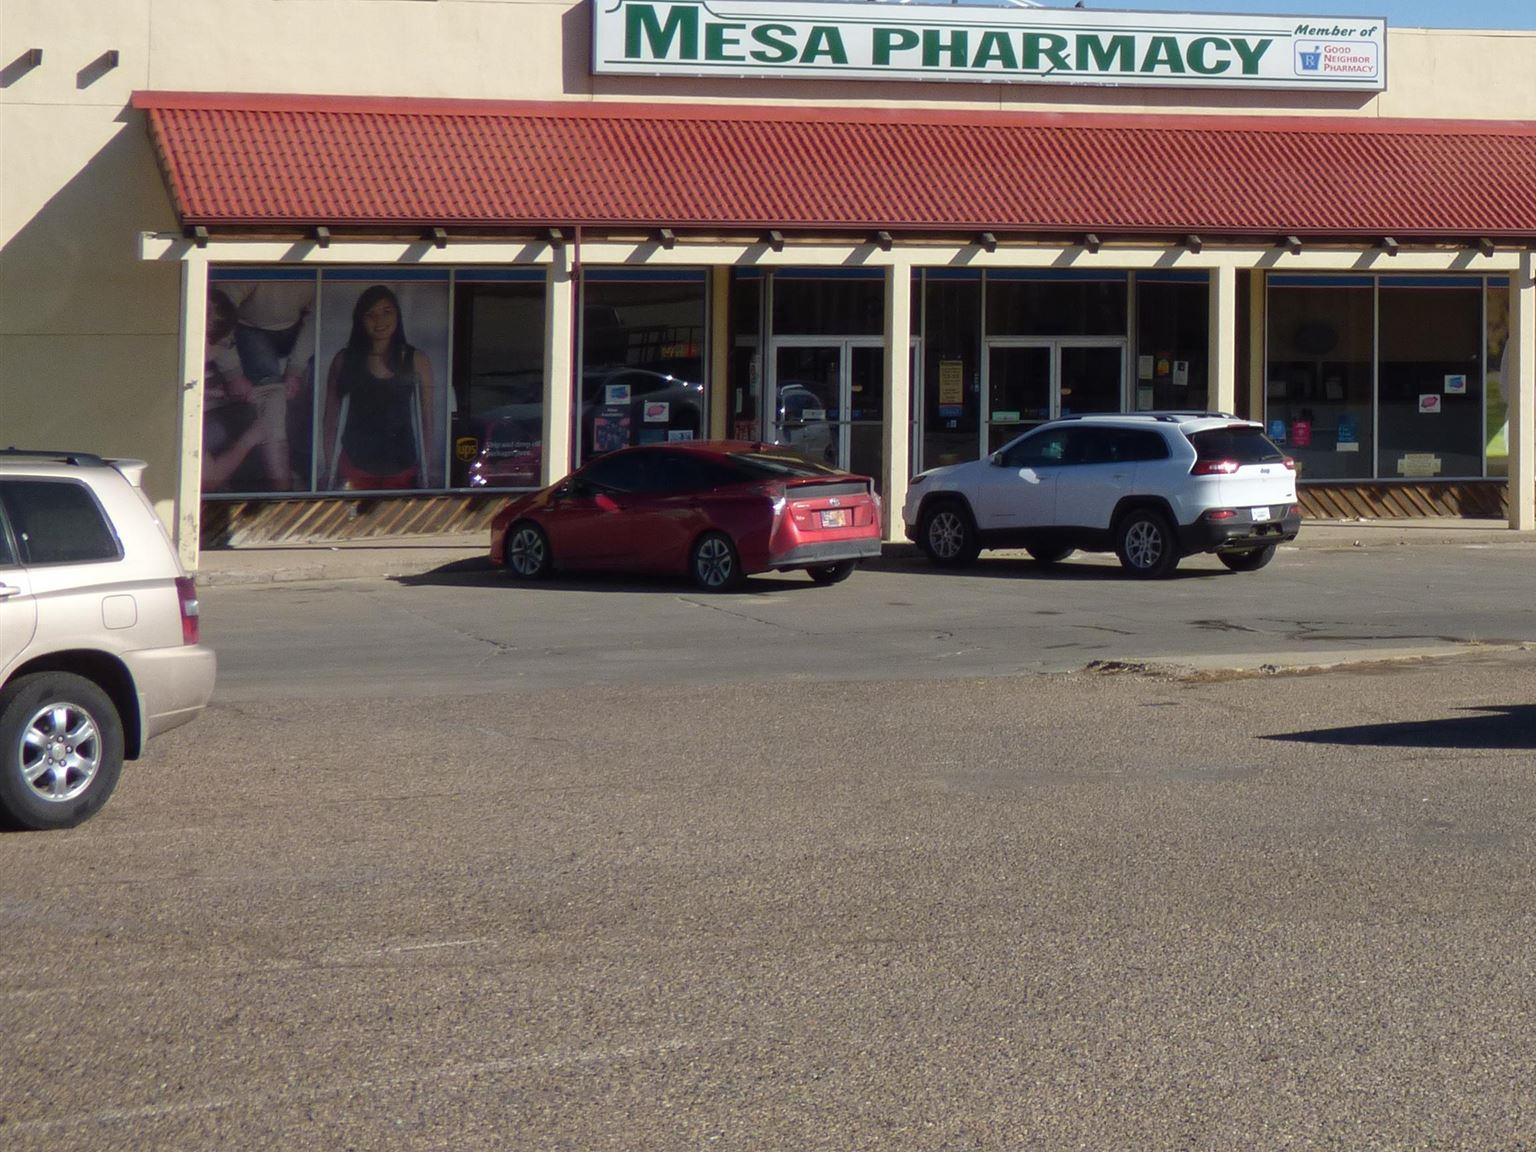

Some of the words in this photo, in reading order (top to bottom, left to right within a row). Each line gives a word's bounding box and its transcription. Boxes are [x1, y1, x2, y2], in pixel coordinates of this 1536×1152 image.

[1294, 24, 1357, 37] Member
[1360, 26, 1378, 37] of
[624, 3, 849, 64] MESA
[871, 27, 1274, 77] PHARMACY
[1323, 45, 1351, 54] GOOD
[1323, 55, 1371, 63] NEIGHBOR
[1323, 64, 1374, 73] PHARMACY
